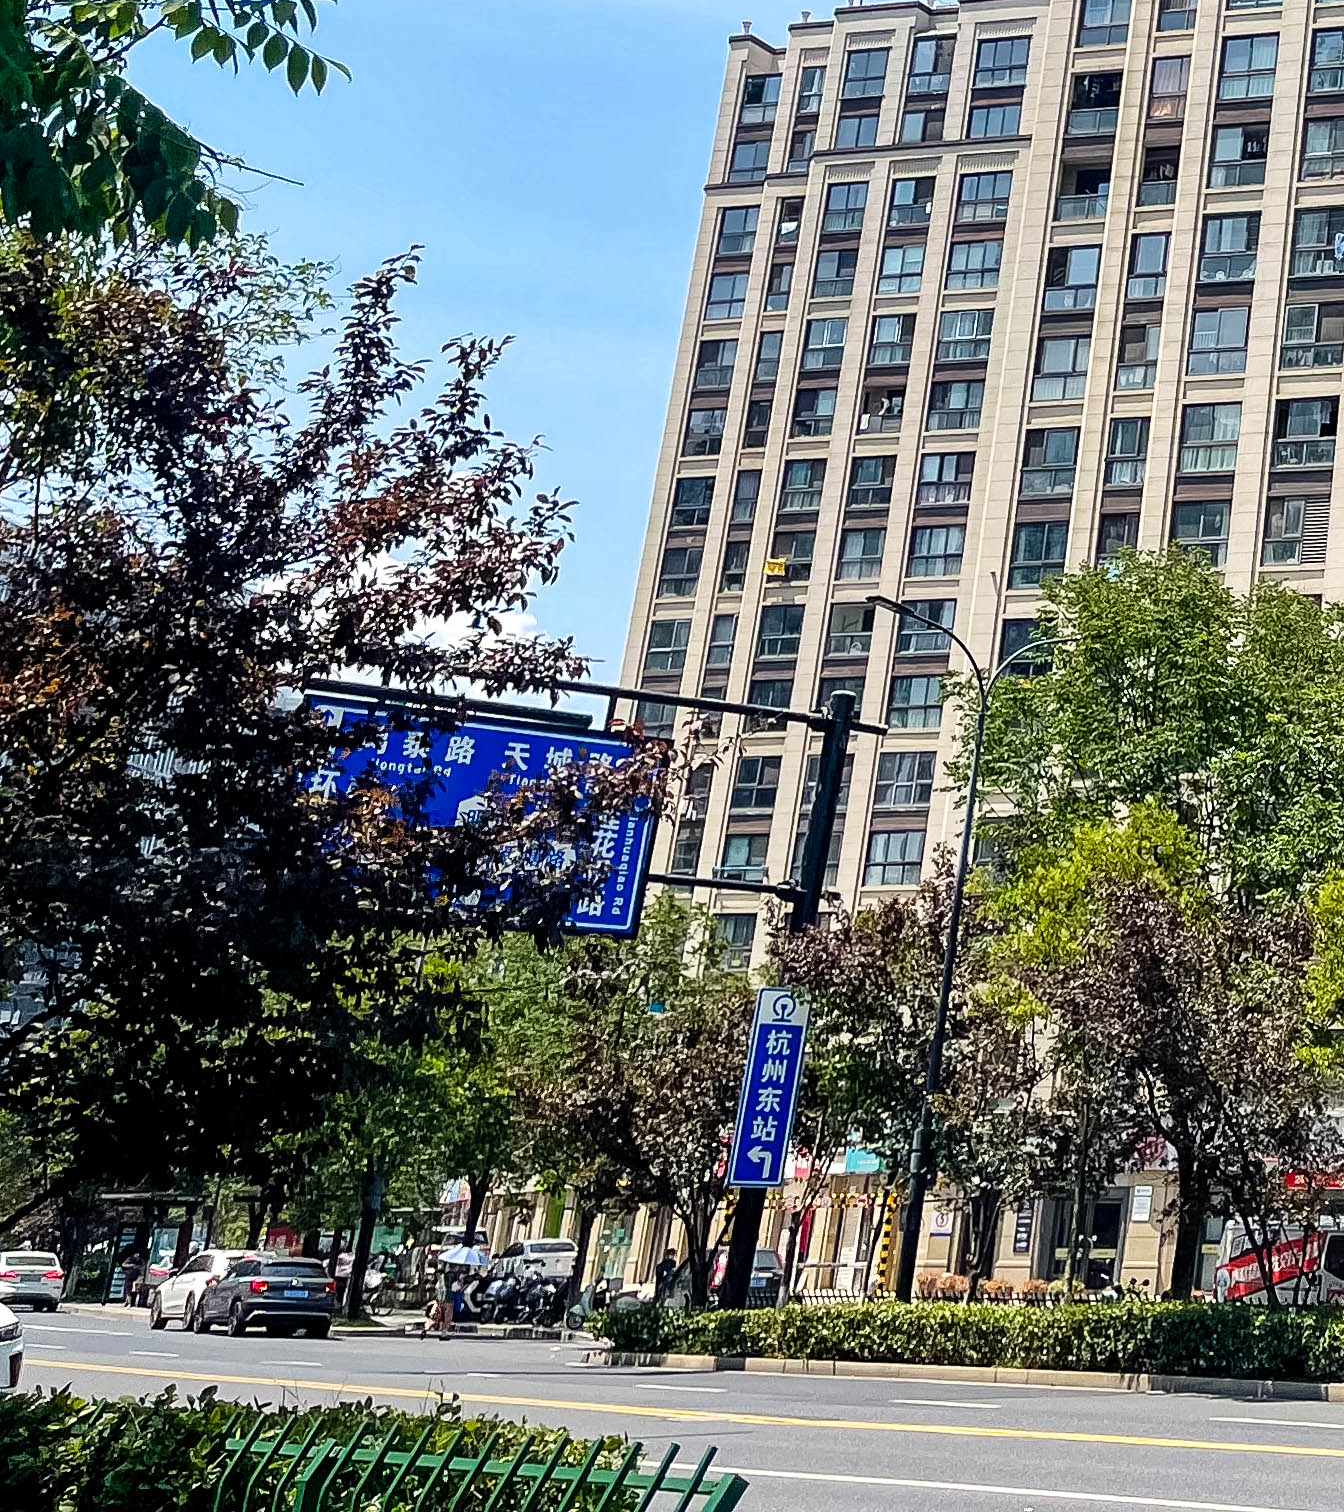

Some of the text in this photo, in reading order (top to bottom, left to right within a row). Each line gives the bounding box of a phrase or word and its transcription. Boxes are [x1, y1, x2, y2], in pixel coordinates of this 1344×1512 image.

[611, 896, 624, 916] Rd
[750, 1029, 793, 1142] 杭州东站
